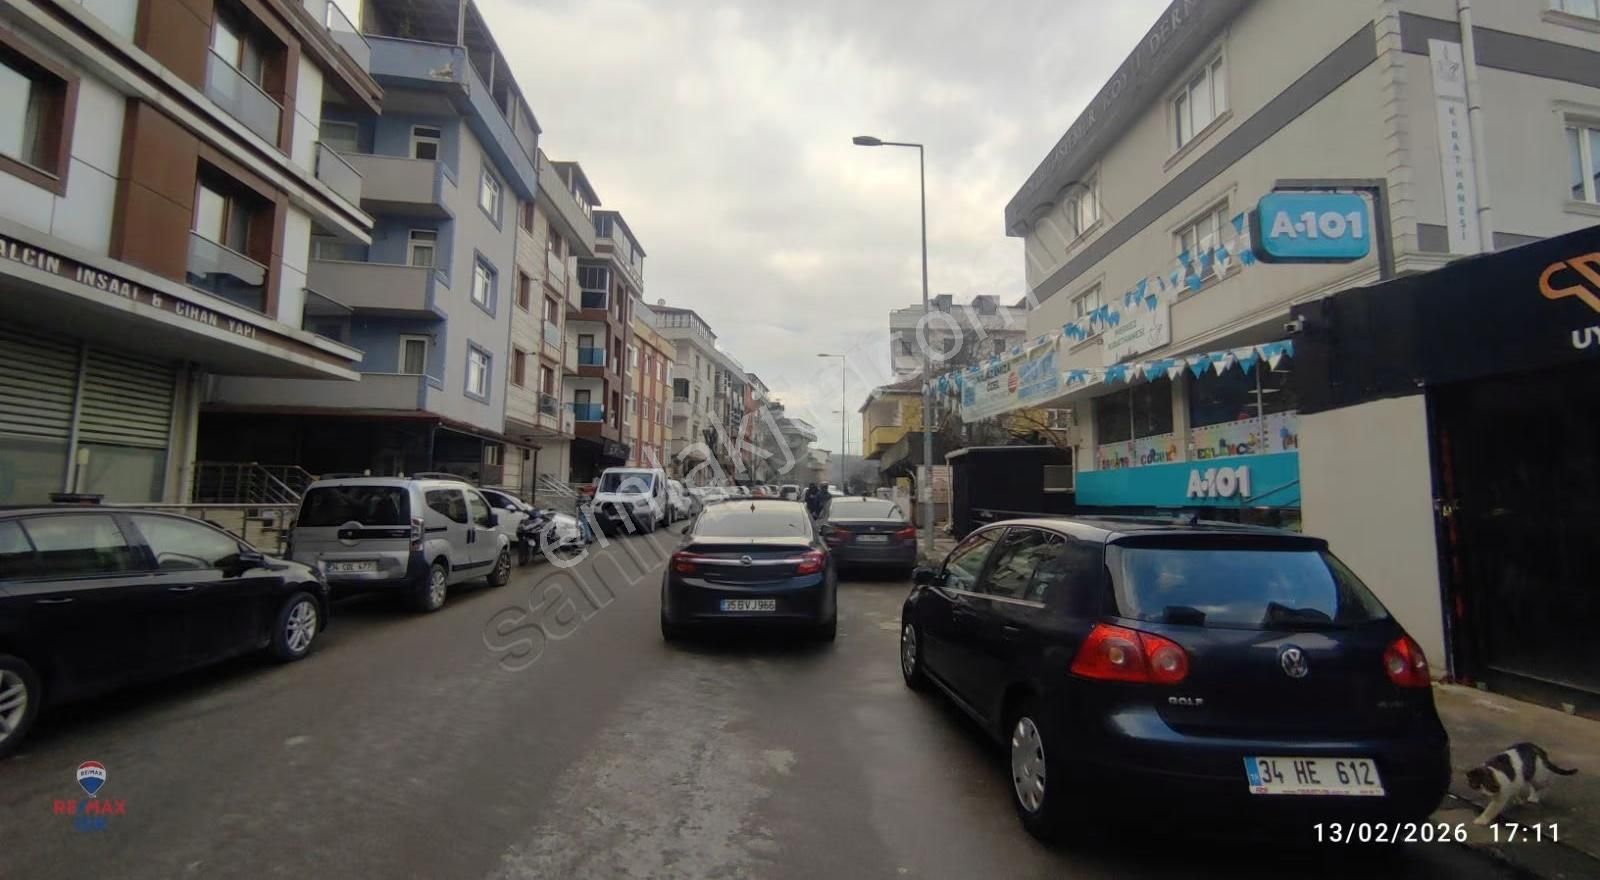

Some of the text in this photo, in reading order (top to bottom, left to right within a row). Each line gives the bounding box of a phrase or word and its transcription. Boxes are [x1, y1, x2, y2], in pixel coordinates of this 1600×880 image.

[1259, 761, 1375, 786] 34 HE 612
